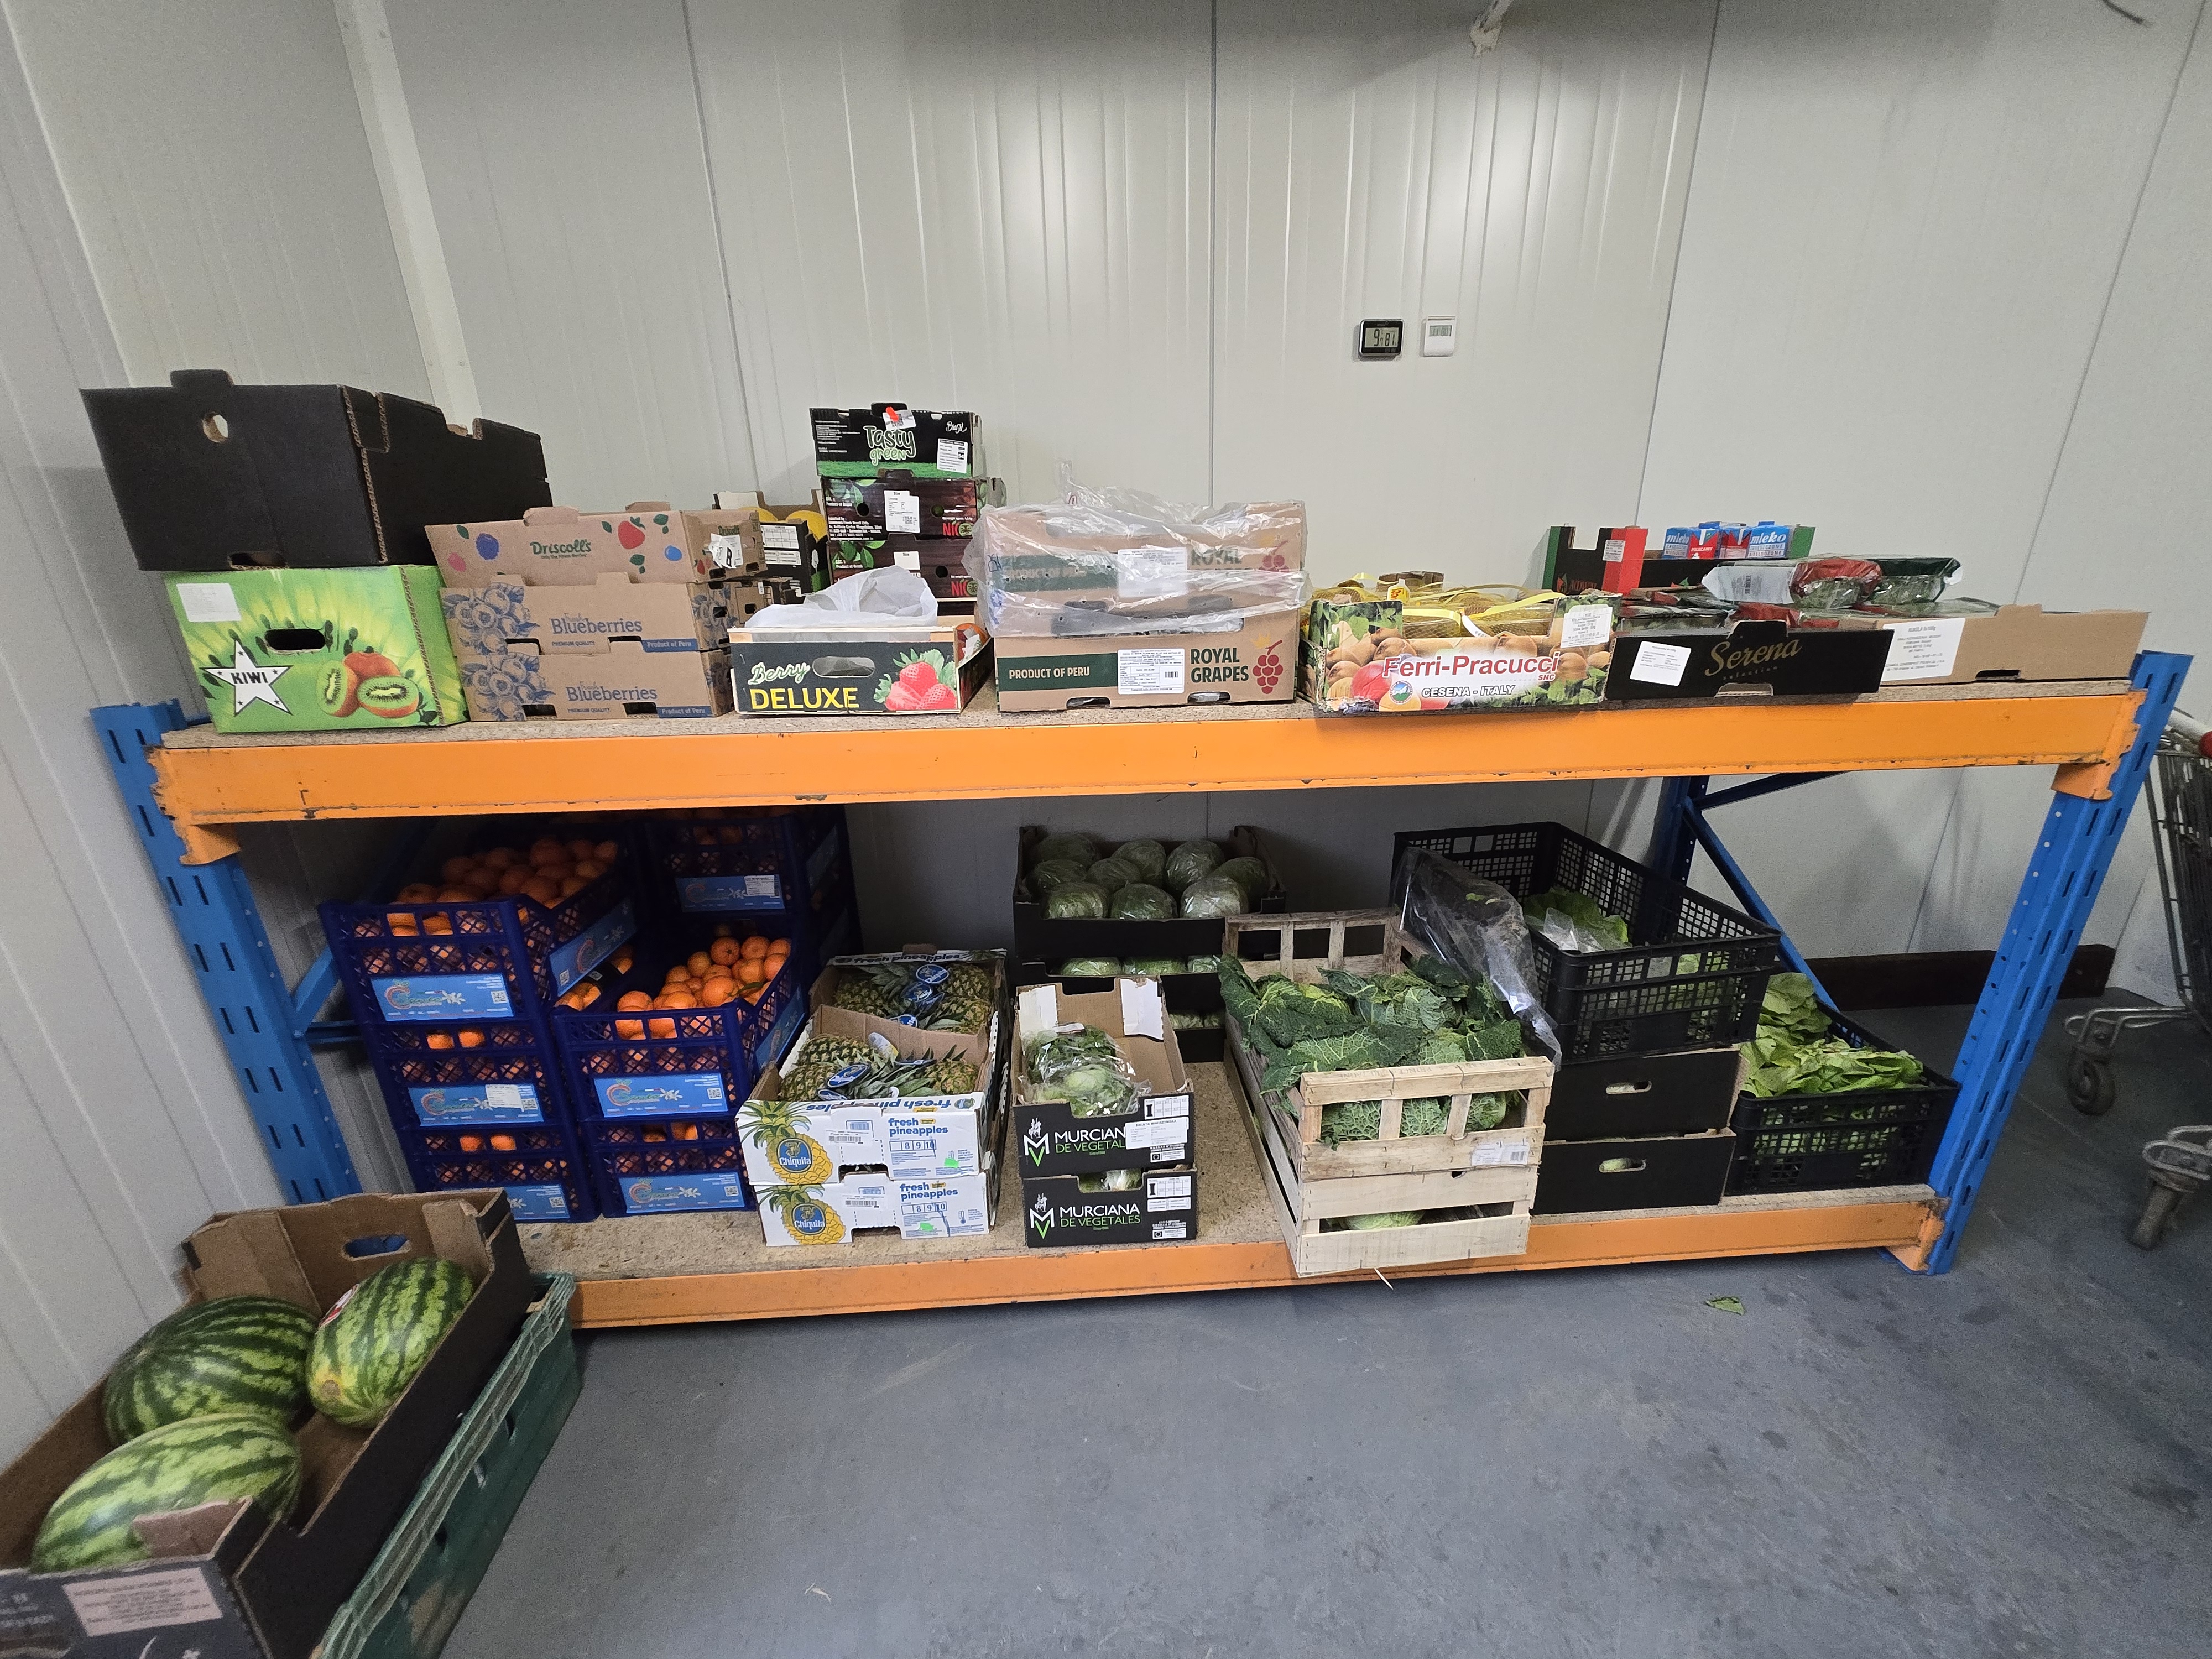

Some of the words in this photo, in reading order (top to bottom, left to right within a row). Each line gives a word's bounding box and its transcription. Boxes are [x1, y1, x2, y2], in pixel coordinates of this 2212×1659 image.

[863, 426, 916, 458] Tasty
[1751, 531, 1786, 544] mleko
[530, 539, 592, 555] Driscoll's
[550, 618, 643, 634] Blueberries
[1191, 648, 1240, 665] ROYAL
[1704, 639, 1802, 676] Serena
[1383, 651, 1561, 678] Ferri-Pracucci
[231, 672, 269, 684] KIWI
[748, 661, 811, 686] Berry
[1009, 669, 1051, 680] PRODUCT
[1053, 667, 1065, 677] OF
[1067, 666, 1090, 676] PERU
[1191, 666, 1249, 683] GRAPES
[1538, 673, 1555, 681] SNC
[566, 686, 658, 701] Blueberries
[750, 687, 860, 709] DELUXE
[1422, 687, 1470, 698] CESENA
[1480, 685, 1516, 696] ITALY
[891, 954, 960, 963] pineapples
[904, 1099, 951, 1109] fresh
[888, 1118, 919, 1126] fresh
[889, 1126, 948, 1137] pineapples
[1055, 1126, 1125, 1144] MURCIAN
[1056, 1143, 1072, 1154] DE
[1074, 1140, 1125, 1152] VEGETAL
[779, 1157, 811, 1167] Chiquita
[900, 1182, 929, 1192] fresh
[901, 1189, 958, 1202] pineapples
[1060, 1203, 1140, 1218] MURCIANA
[794, 1220, 825, 1230] Chiquita
[1061, 1218, 1076, 1227] DE
[1078, 1215, 1141, 1227] VEGETALES
